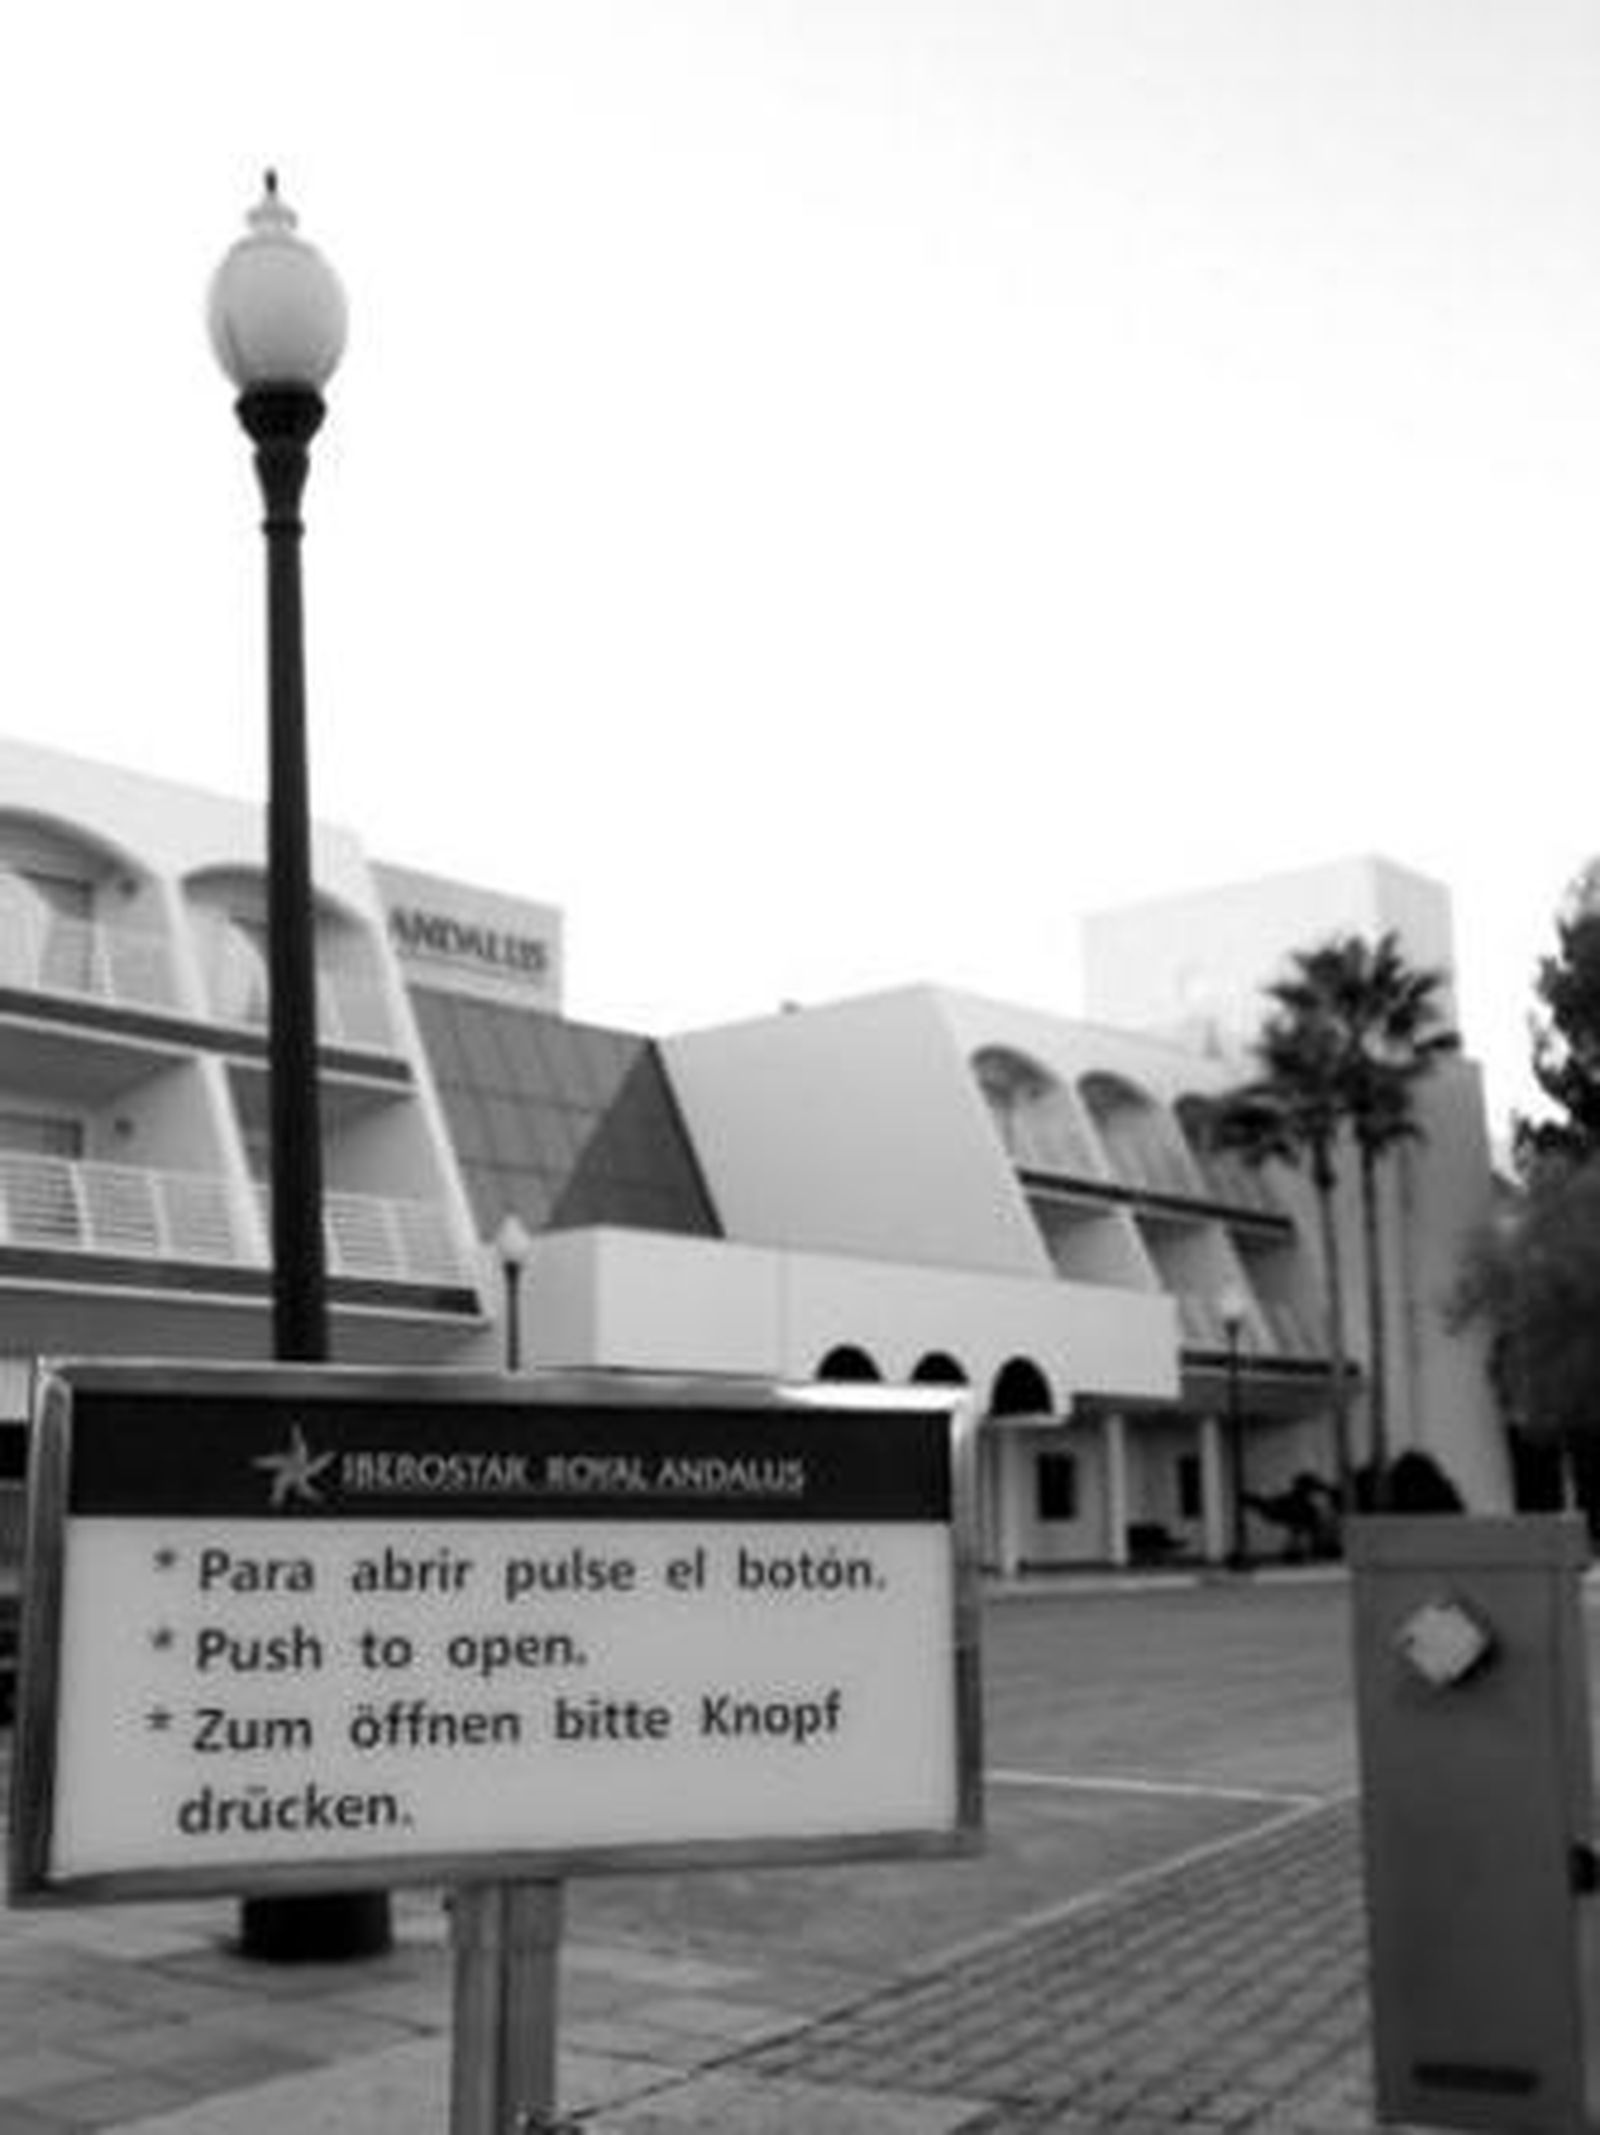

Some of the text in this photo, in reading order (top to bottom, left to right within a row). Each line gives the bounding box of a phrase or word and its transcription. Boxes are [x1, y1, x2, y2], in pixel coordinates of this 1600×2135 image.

[342, 1452, 806, 1494] IBEROSTAR ROYAL ANDALUS
[199, 1548, 316, 1593] Para
[350, 1546, 475, 1593] abrir
[505, 1547, 637, 1600] pulse
[665, 1547, 706, 1591] el
[195, 1625, 588, 1678] Push to open.
[193, 1689, 841, 1753] Zum öffnen bitte Knopf
[178, 1783, 414, 1835] drücken.
